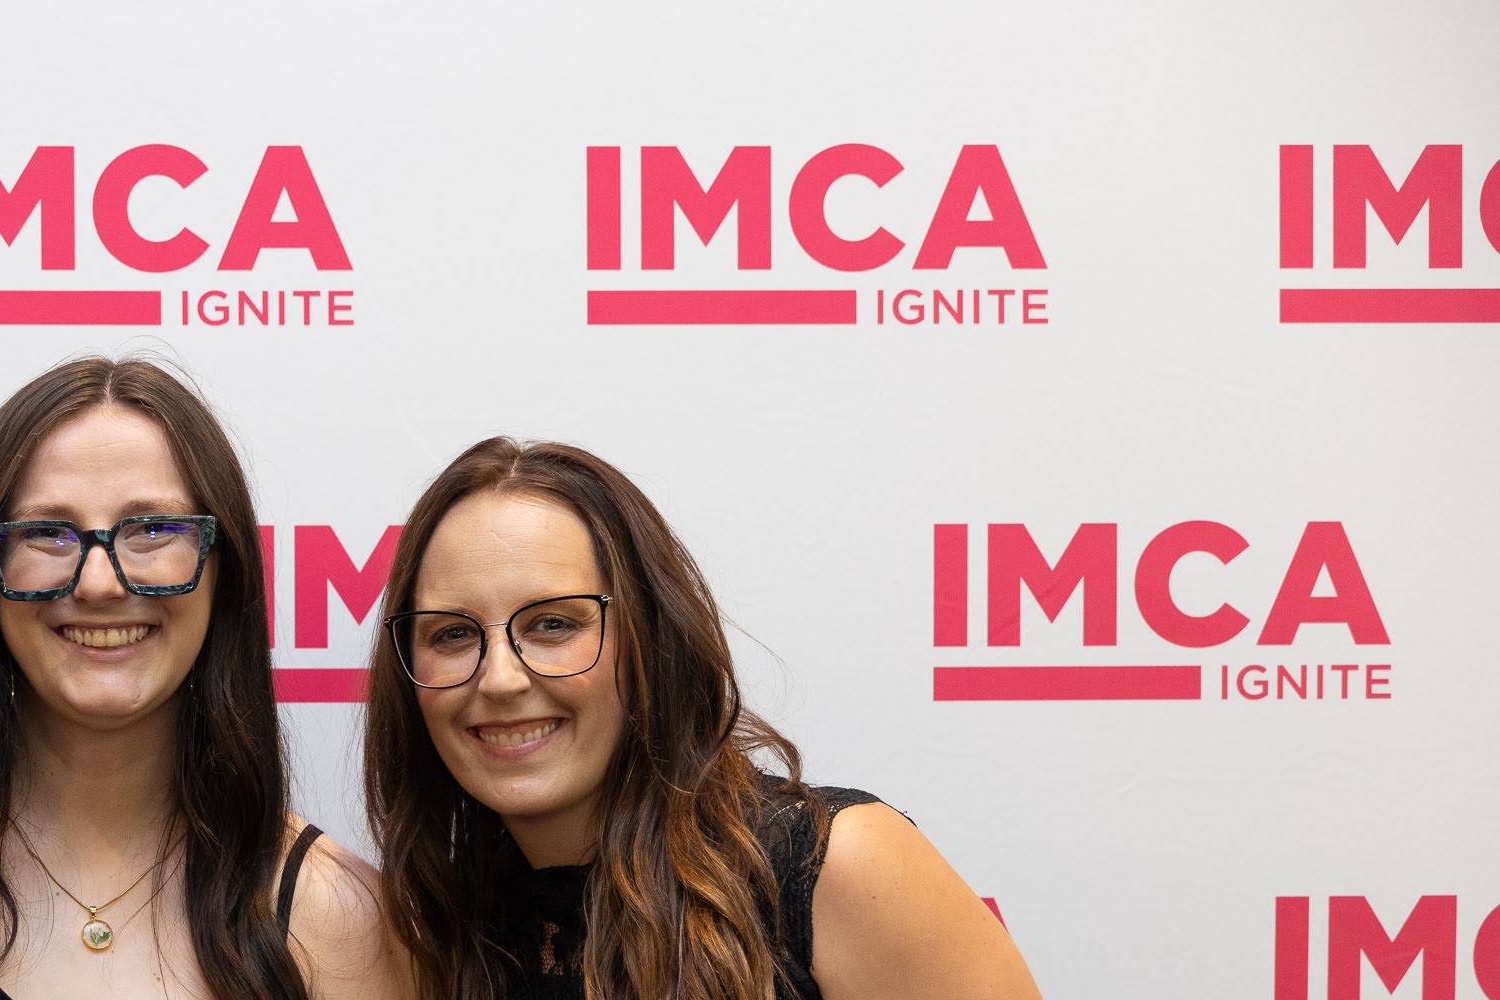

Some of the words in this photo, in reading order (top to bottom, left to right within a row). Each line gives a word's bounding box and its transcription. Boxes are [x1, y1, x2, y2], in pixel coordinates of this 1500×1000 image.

[586, 144, 1047, 271] IMCA
[1279, 144, 1500, 269] IM
[182, 291, 354, 326] IGNITE
[877, 290, 1048, 325] IGNITE
[933, 521, 1391, 648] IMCA
[1221, 665, 1391, 700] IGNITE
